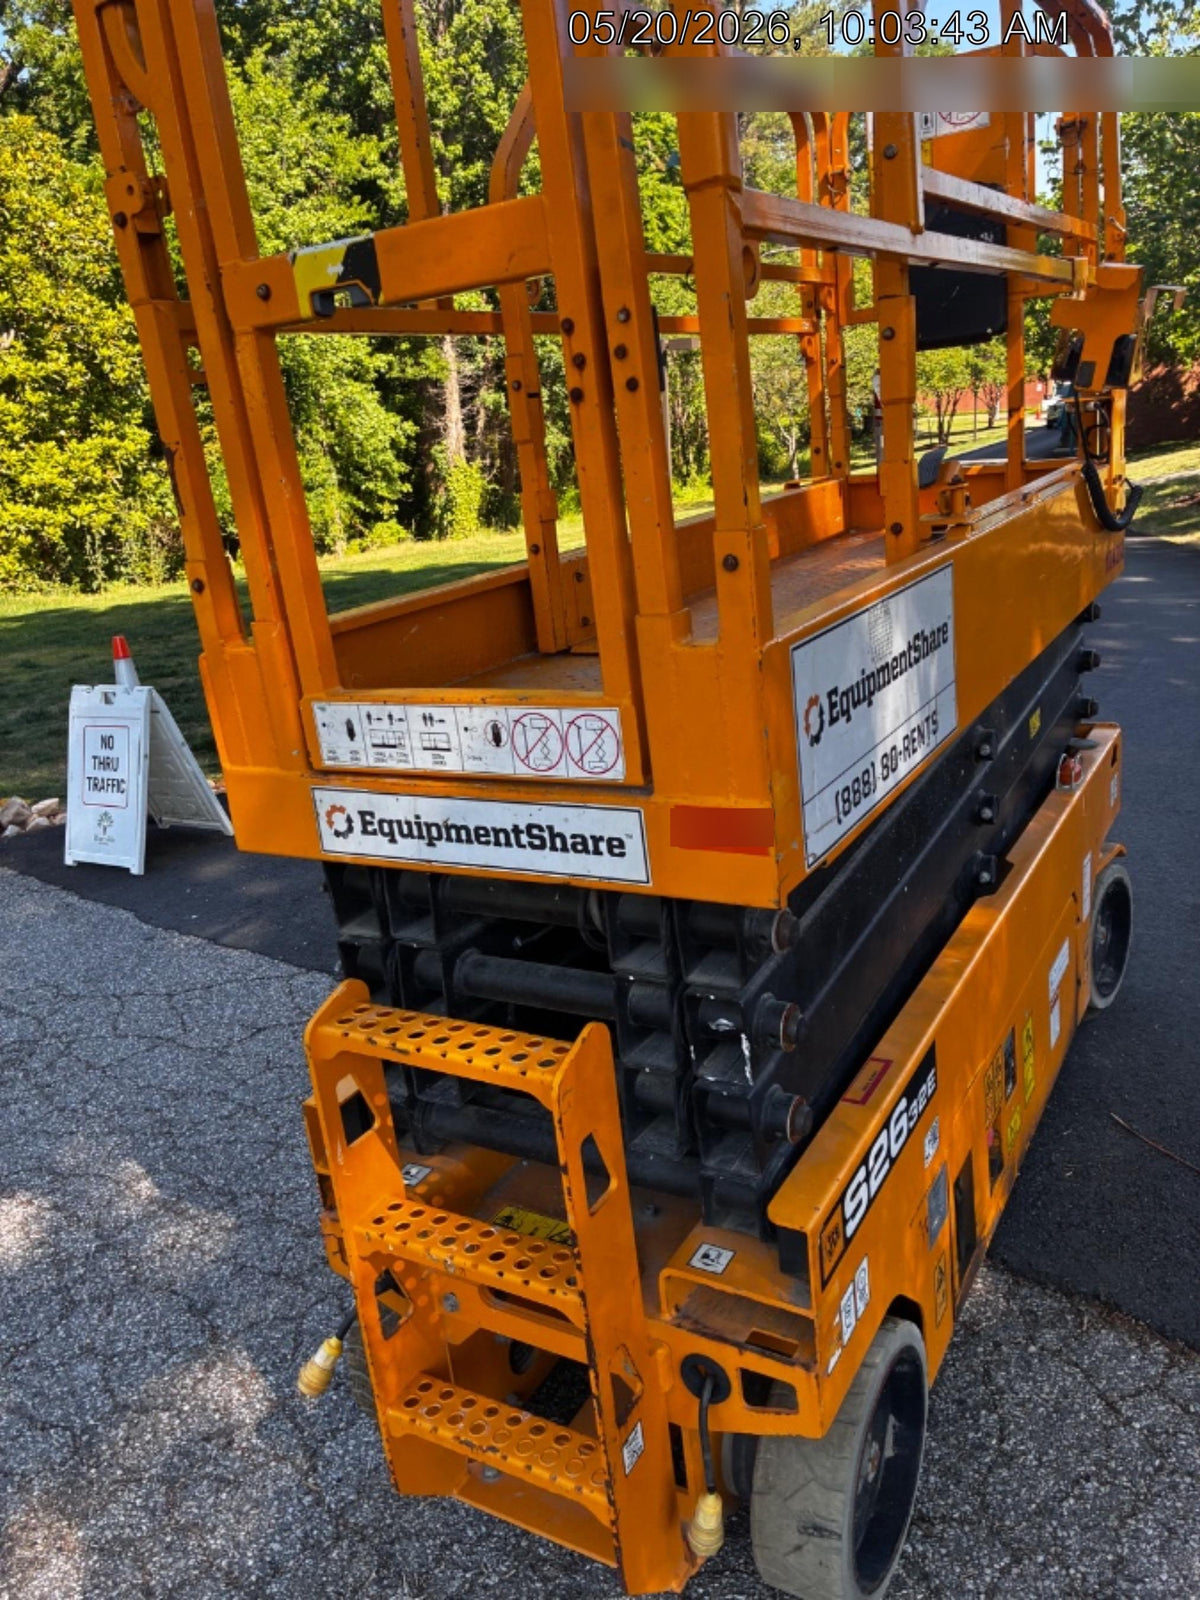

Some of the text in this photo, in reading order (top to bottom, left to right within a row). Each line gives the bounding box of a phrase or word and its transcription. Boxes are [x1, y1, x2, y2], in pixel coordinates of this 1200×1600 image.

[826, 621, 949, 729] EquipmentShare
[100, 735, 114, 750] NO
[92, 755, 119, 771] THRU
[835, 709, 939, 824] (888) 80-RENTS
[86, 776, 126, 794] TRAFFIC
[357, 810, 627, 858] EquipmentShare
